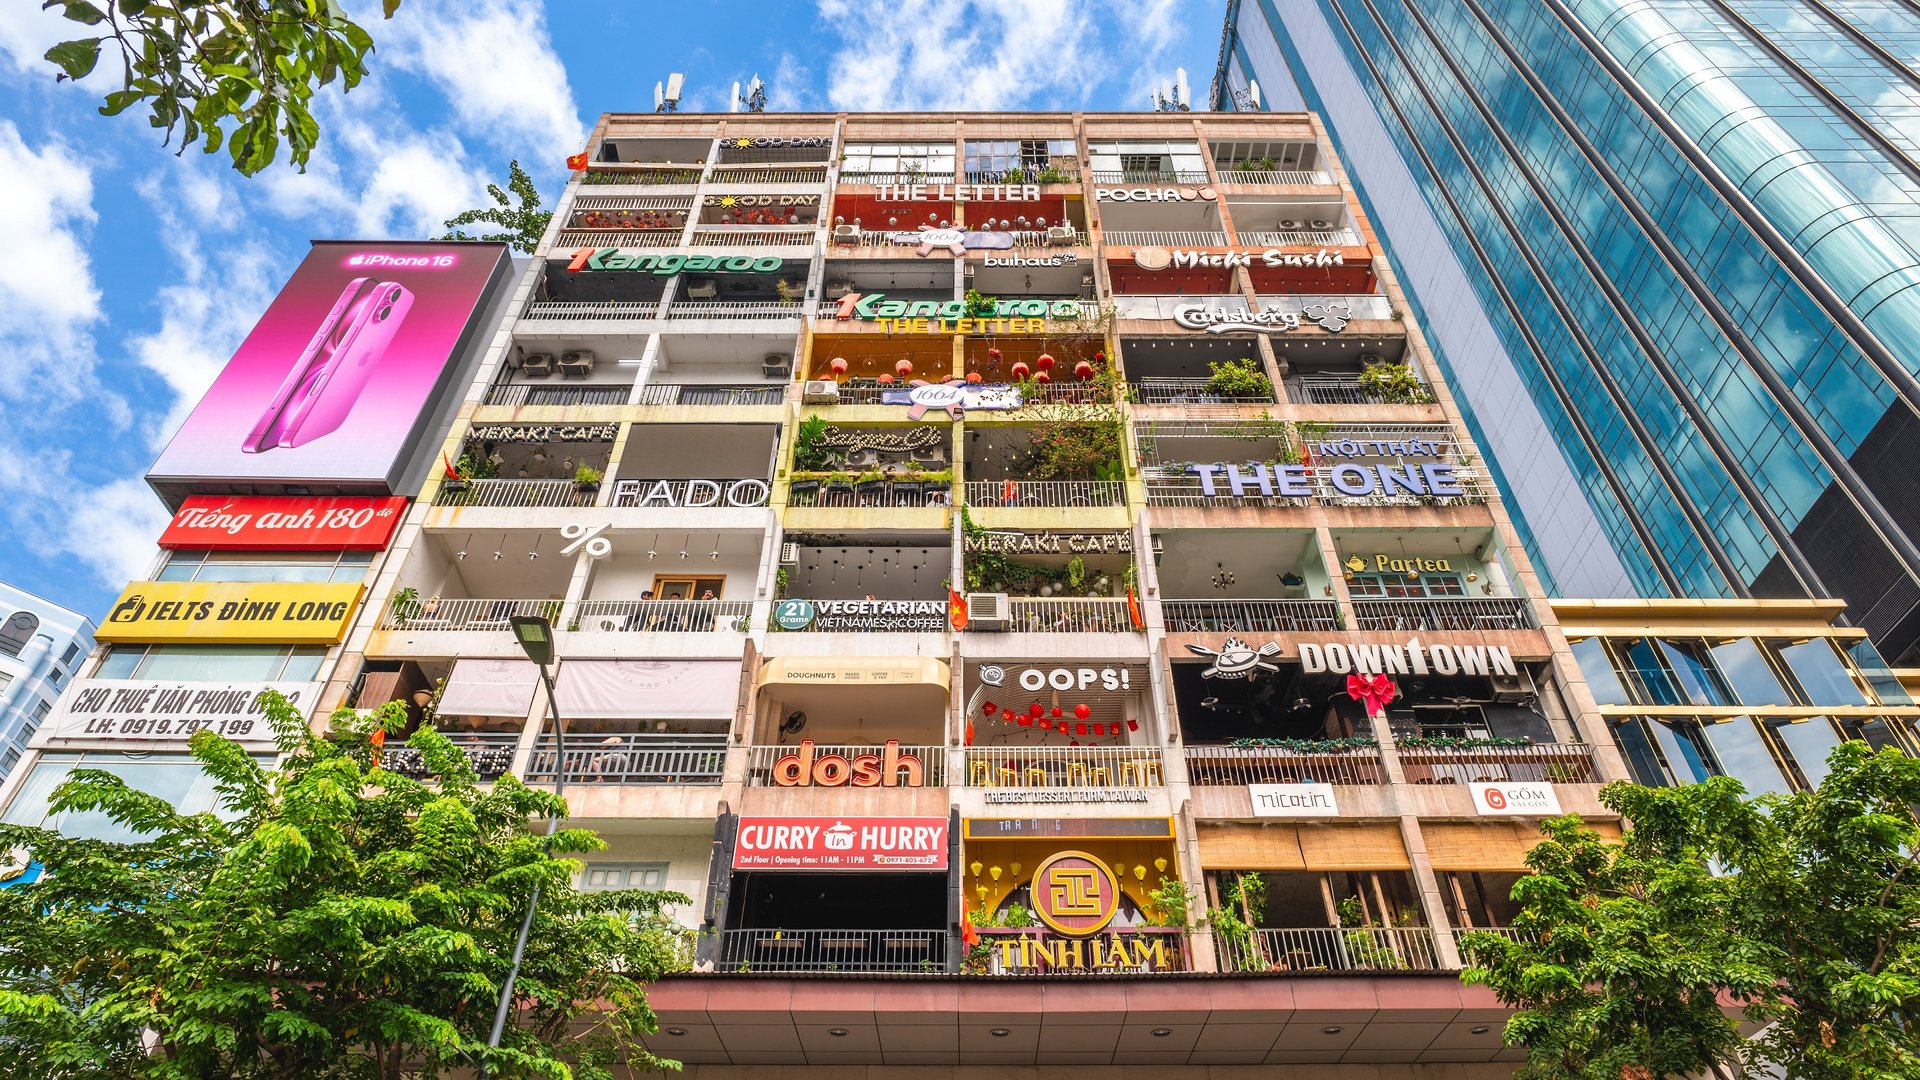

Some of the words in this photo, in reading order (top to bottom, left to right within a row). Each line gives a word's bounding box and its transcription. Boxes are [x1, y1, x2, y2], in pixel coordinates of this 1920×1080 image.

[780, 194, 818, 206] DAY
[876, 184, 928, 201] THE
[938, 184, 1041, 201] LETTER
[1095, 187, 1181, 202] POCHA
[364, 254, 430, 266] iPhone
[433, 255, 454, 267] 16
[1173, 249, 1250, 269] Michi
[1262, 248, 1344, 268] Sushi
[875, 318, 930, 334] THE
[940, 317, 1046, 334] LETTER
[1173, 303, 1300, 334] Carlsberg
[916, 388, 958, 401] 1664
[466, 425, 553, 443] MERAKI
[1186, 463, 1313, 498] THE
[1330, 462, 1464, 498] ONE
[611, 478, 771, 508] FADO
[177, 503, 253, 535] Tiếng
[255, 507, 319, 529] anh
[316, 506, 376, 529] 180
[963, 534, 1060, 555] MERAKI
[1374, 553, 1452, 573] Partea
[145, 600, 215, 621] IELTS
[216, 597, 281, 621] ĐÌNH
[282, 601, 348, 622] LONG
[784, 601, 807, 617] 21
[816, 601, 946, 615] VEGETARIAN
[779, 616, 809, 624] Grams
[896, 616, 944, 629] COFFEE
[787, 671, 836, 679] DOUGHNUTS
[1019, 668, 1131, 692] OOPS!
[70, 687, 111, 714] CHO
[106, 684, 157, 714] THUÊ
[151, 684, 194, 714] VĂN
[84, 718, 117, 734] LH:
[119, 719, 255, 735] 0919.797199
[773, 739, 924, 788] dosh
[985, 791, 1004, 803] THE
[1006, 791, 1030, 803] BEST
[1033, 791, 1076, 803] DESSERT
[1106, 790, 1149, 803] TAIWAN
[1257, 792, 1332, 808] nicotin
[740, 825, 821, 850] CURRY
[860, 826, 944, 850] HURRY
[775, 856, 801, 865] Opening
[802, 856, 818, 864] time:
[820, 856, 839, 864] 11AM
[846, 856, 865, 864] 11PM
